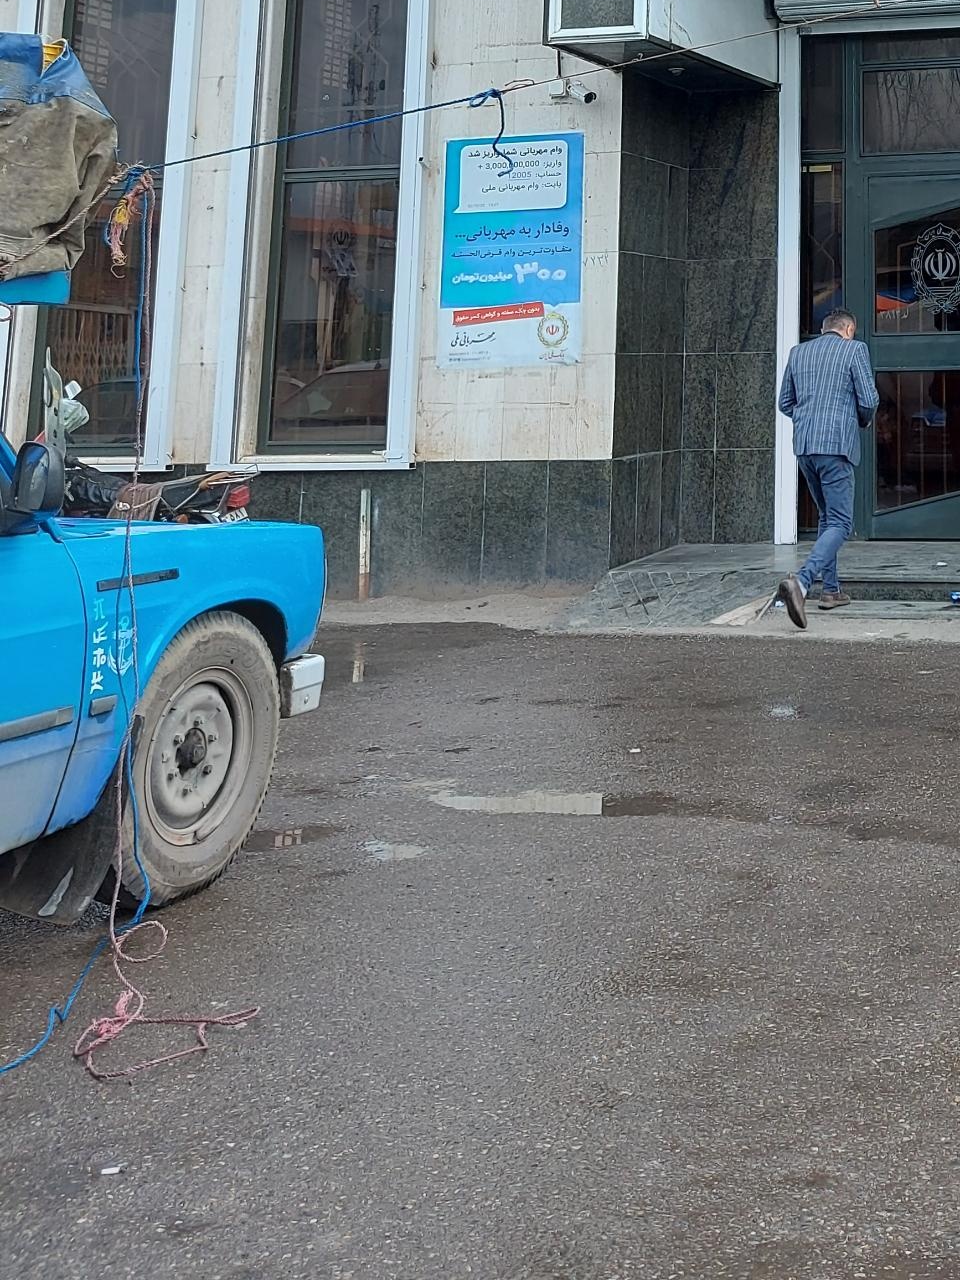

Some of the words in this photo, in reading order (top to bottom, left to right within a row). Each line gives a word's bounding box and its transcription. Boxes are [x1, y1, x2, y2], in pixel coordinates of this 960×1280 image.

[468, 150, 481, 158] شد
[503, 148, 518, 156] شما
[519, 146, 548, 157] مهربانی
[550, 145, 563, 155] وام
[482, 184, 496, 193] ملی
[498, 183, 526, 193] مهربانی
[527, 181, 539, 191] وام
[519, 224, 531, 238] به
[534, 220, 570, 238] وفادار
[504, 248, 516, 257] وام
[514, 261, 567, 284] ۳۰۰
